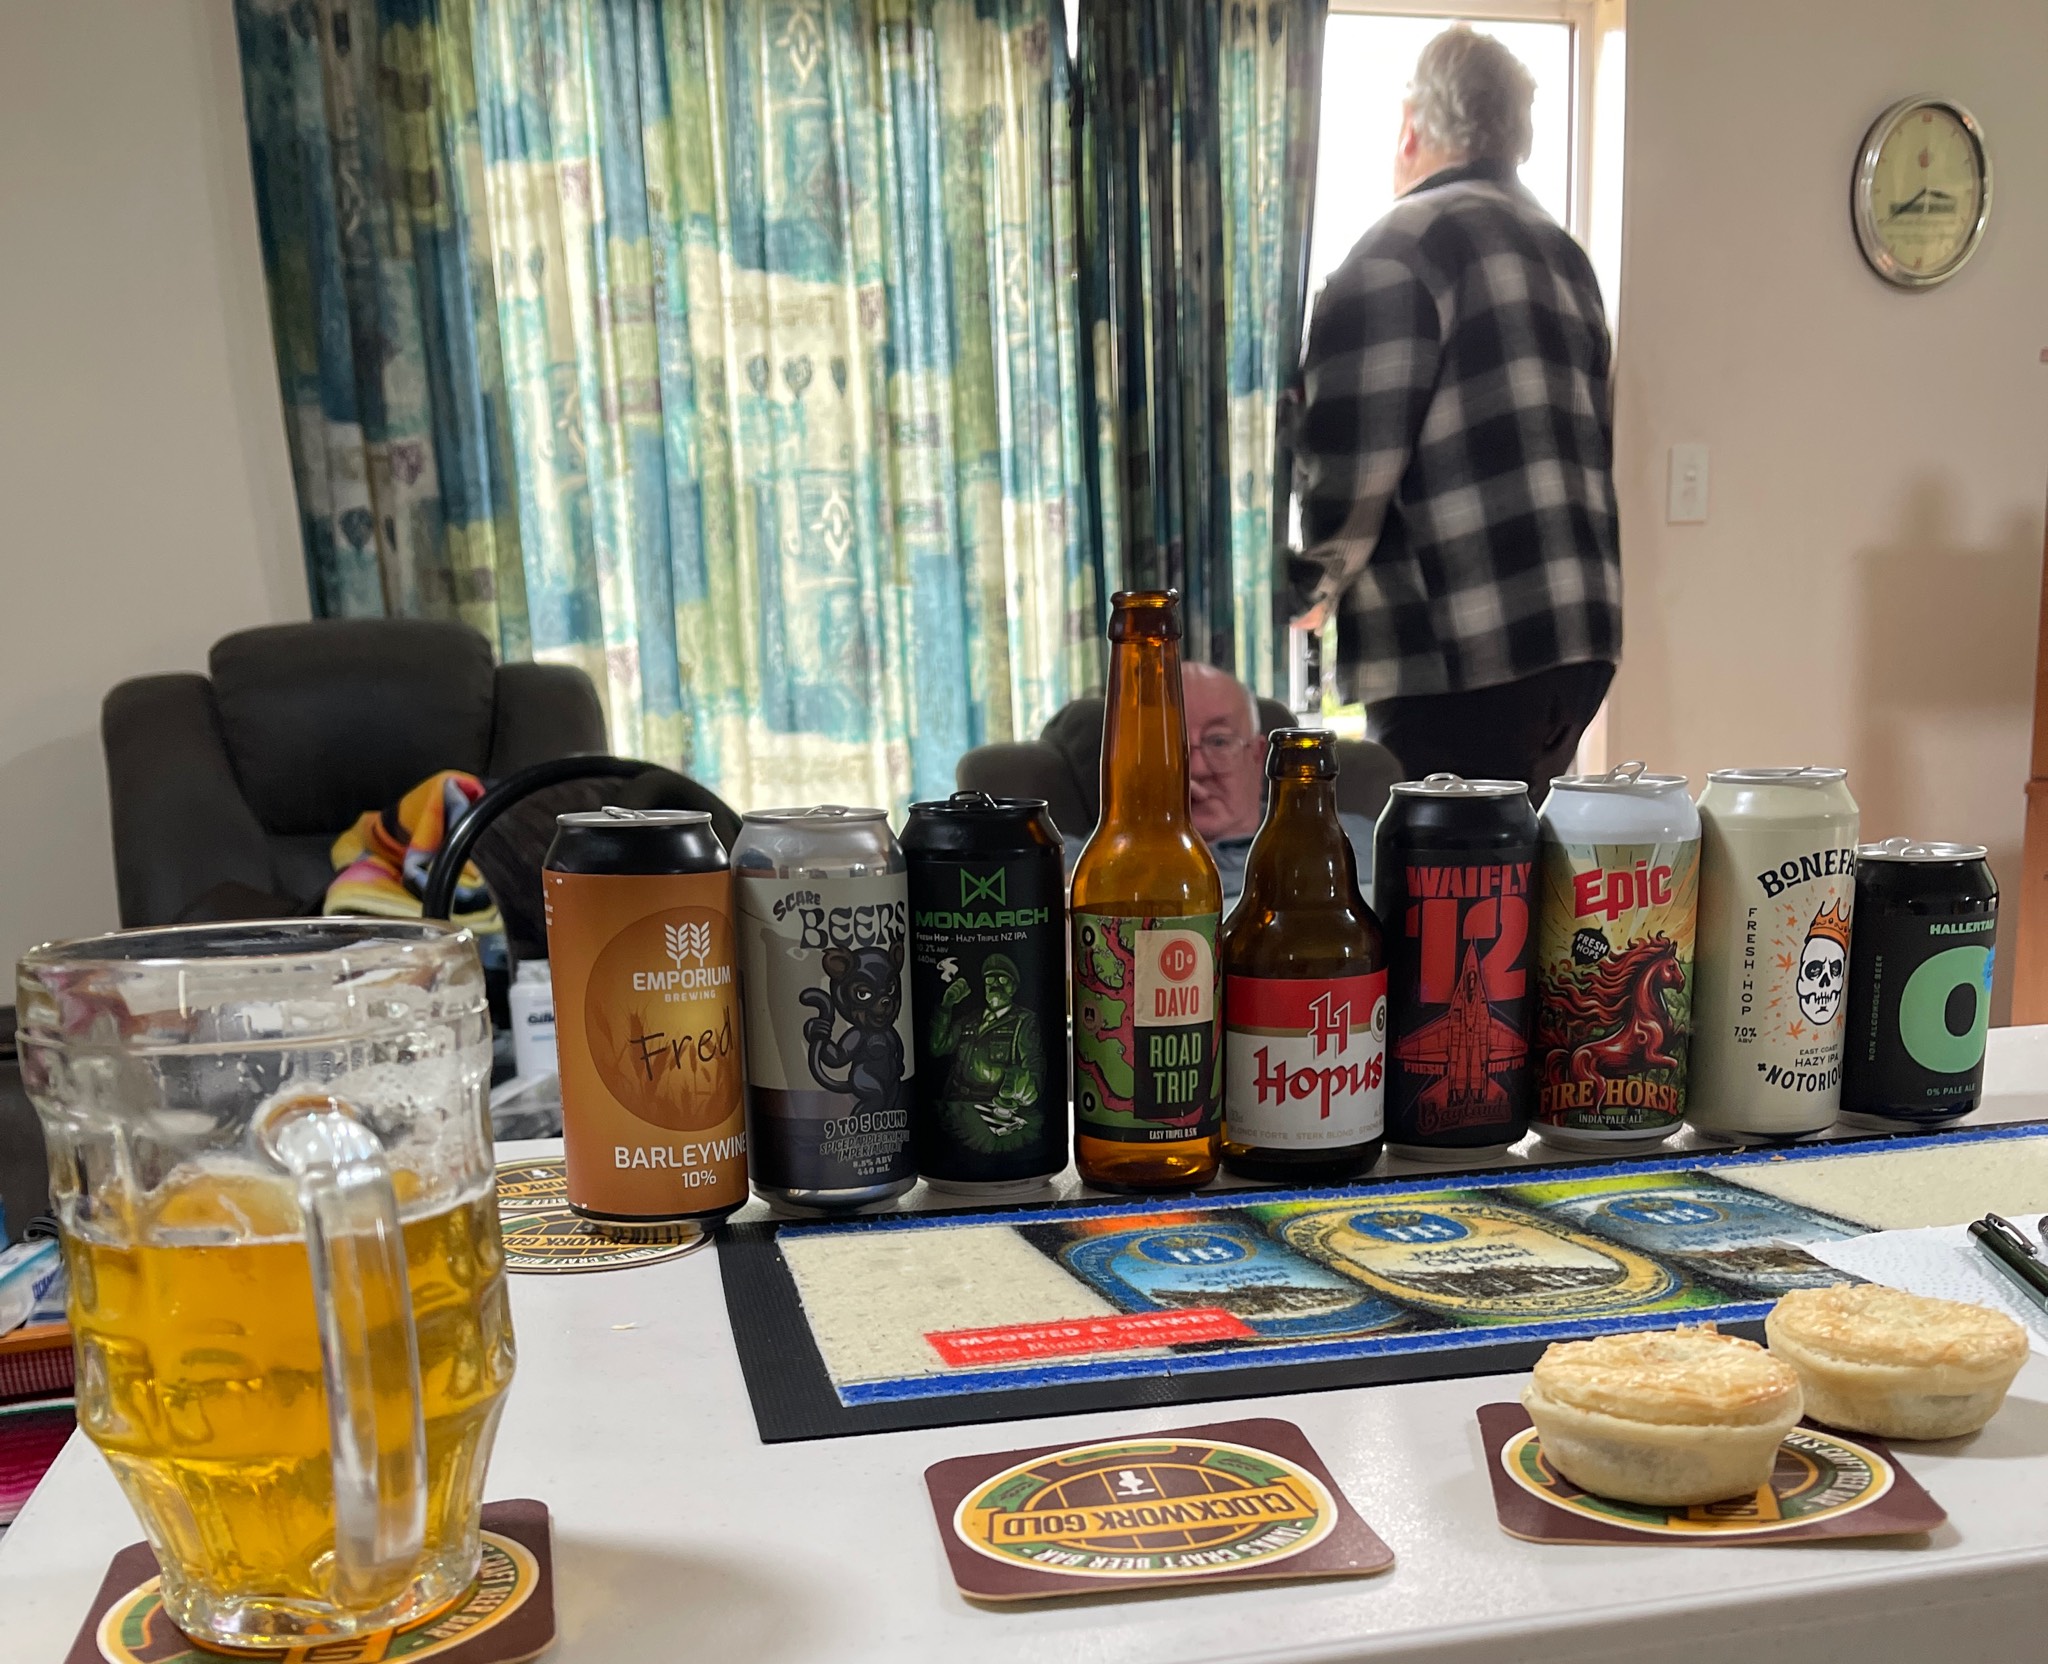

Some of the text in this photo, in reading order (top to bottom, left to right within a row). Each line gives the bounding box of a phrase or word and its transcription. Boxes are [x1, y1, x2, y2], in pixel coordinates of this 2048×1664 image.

[1573, 860, 1672, 921] Epic
[773, 890, 821, 922] SCARE
[799, 900, 906, 949] BEERS
[915, 907, 1049, 929] MONARCH
[956, 934, 975, 943] HAZY
[977, 934, 999, 942] TRIPLE
[1000, 933, 1012, 942] NZ
[1014, 932, 1028, 941] IPA
[1577, 933, 1608, 954] FRESH
[1405, 894, 1529, 1004] 12
[1576, 943, 1600, 961] HOPS
[633, 966, 732, 991] EMPORIUM
[664, 990, 716, 1003] BREWING
[1154, 985, 1199, 1018] DAVO
[1734, 1026, 1756, 1038] 7.0%
[630, 1005, 734, 1081] Fred
[1150, 1032, 1201, 1068] ROAD
[1799, 1044, 1838, 1056] EAST COAST
[1404, 1062, 1444, 1075] FRESH
[1795, 1052, 1839, 1068] HAZY IPA
[1153, 1069, 1198, 1104] TRIP
[1926, 1082, 1976, 1096] 0% PALE ALE
[1540, 1079, 1680, 1116] FIRE HORSE
[824, 1120, 836, 1140] 9
[838, 1116, 858, 1136] TO
[860, 1113, 871, 1132] 5
[1578, 1113, 1644, 1124] INDIA PALE ALE
[1149, 1130, 1164, 1140] EASY
[820, 1136, 855, 1155] SPICED
[682, 1169, 717, 1188] 10%
[876, 1164, 890, 1173] mL
[1004, 1492, 1294, 1538] CLOCKWORK GOLD
[1032, 1548, 1086, 1566] BAR
[1088, 1556, 1150, 1570] BEER
[1163, 1548, 1240, 1569] CRAFT
